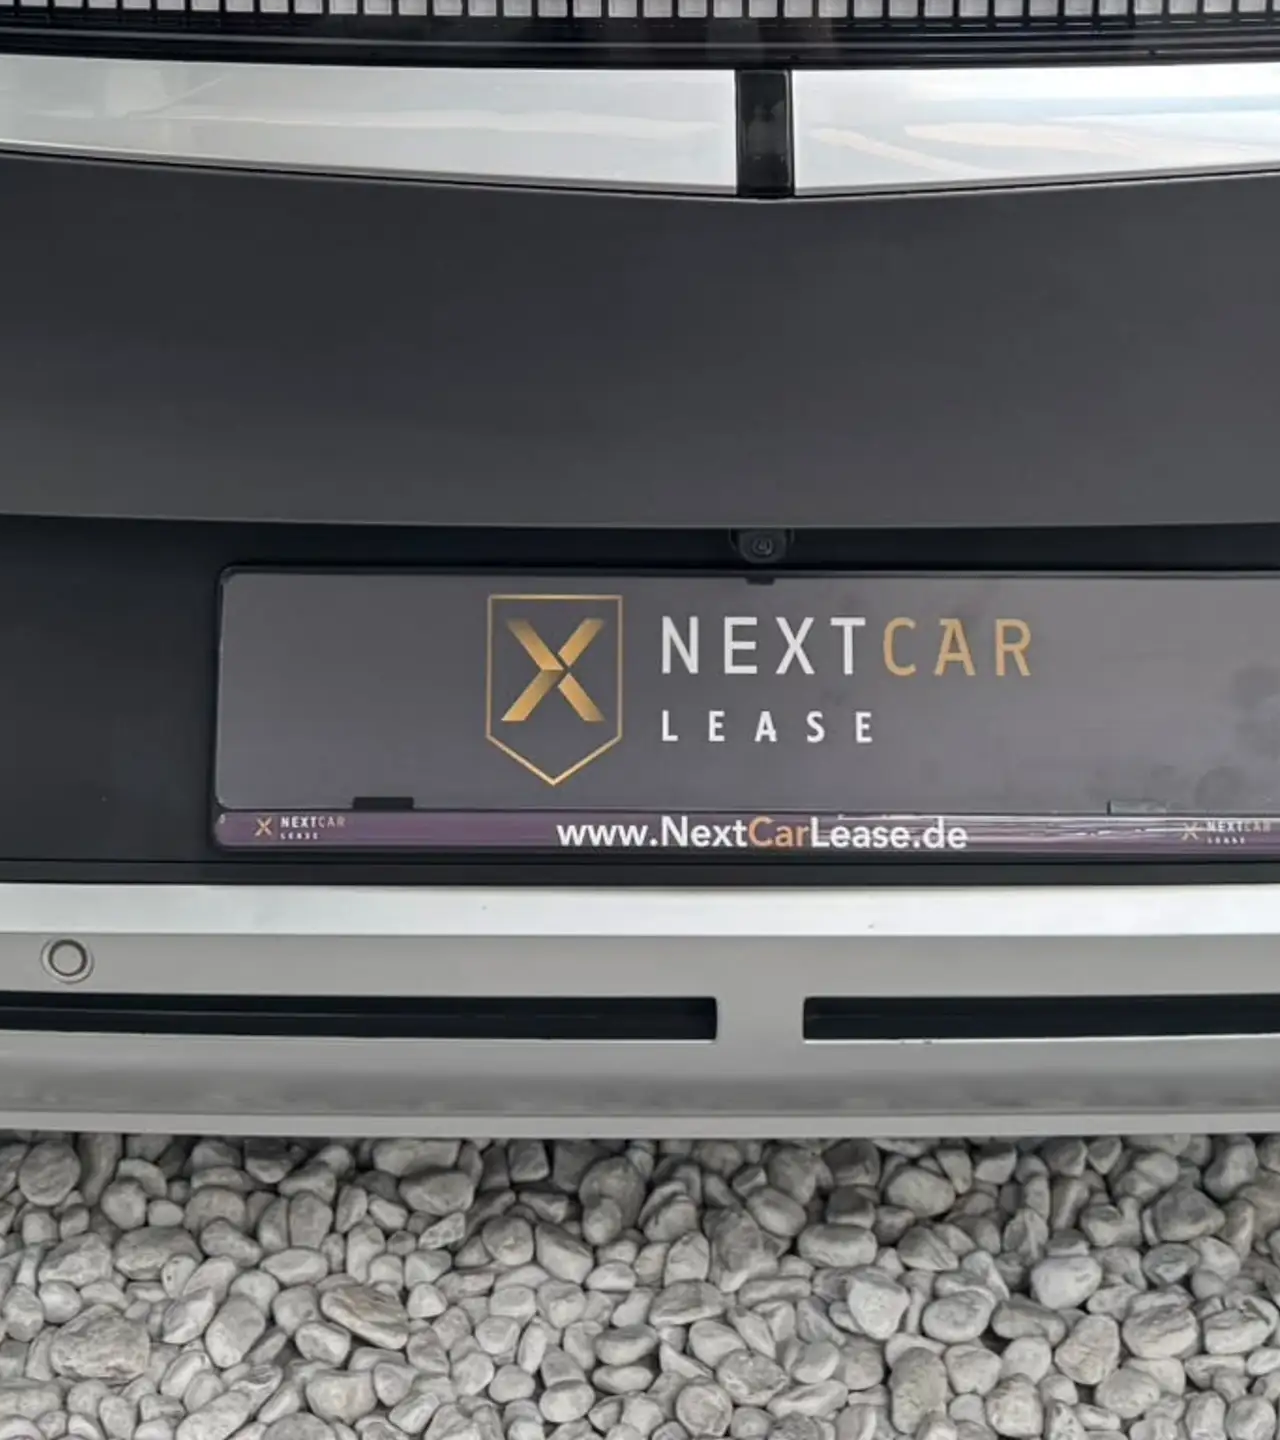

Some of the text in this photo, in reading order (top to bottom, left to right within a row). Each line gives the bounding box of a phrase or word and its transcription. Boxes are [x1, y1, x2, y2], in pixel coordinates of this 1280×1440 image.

[661, 615, 1032, 677] NEXTCAR
[661, 709, 873, 744] LEASE
[279, 815, 346, 829] NEXTCAR
[556, 815, 969, 849] www.NextCarLease.de
